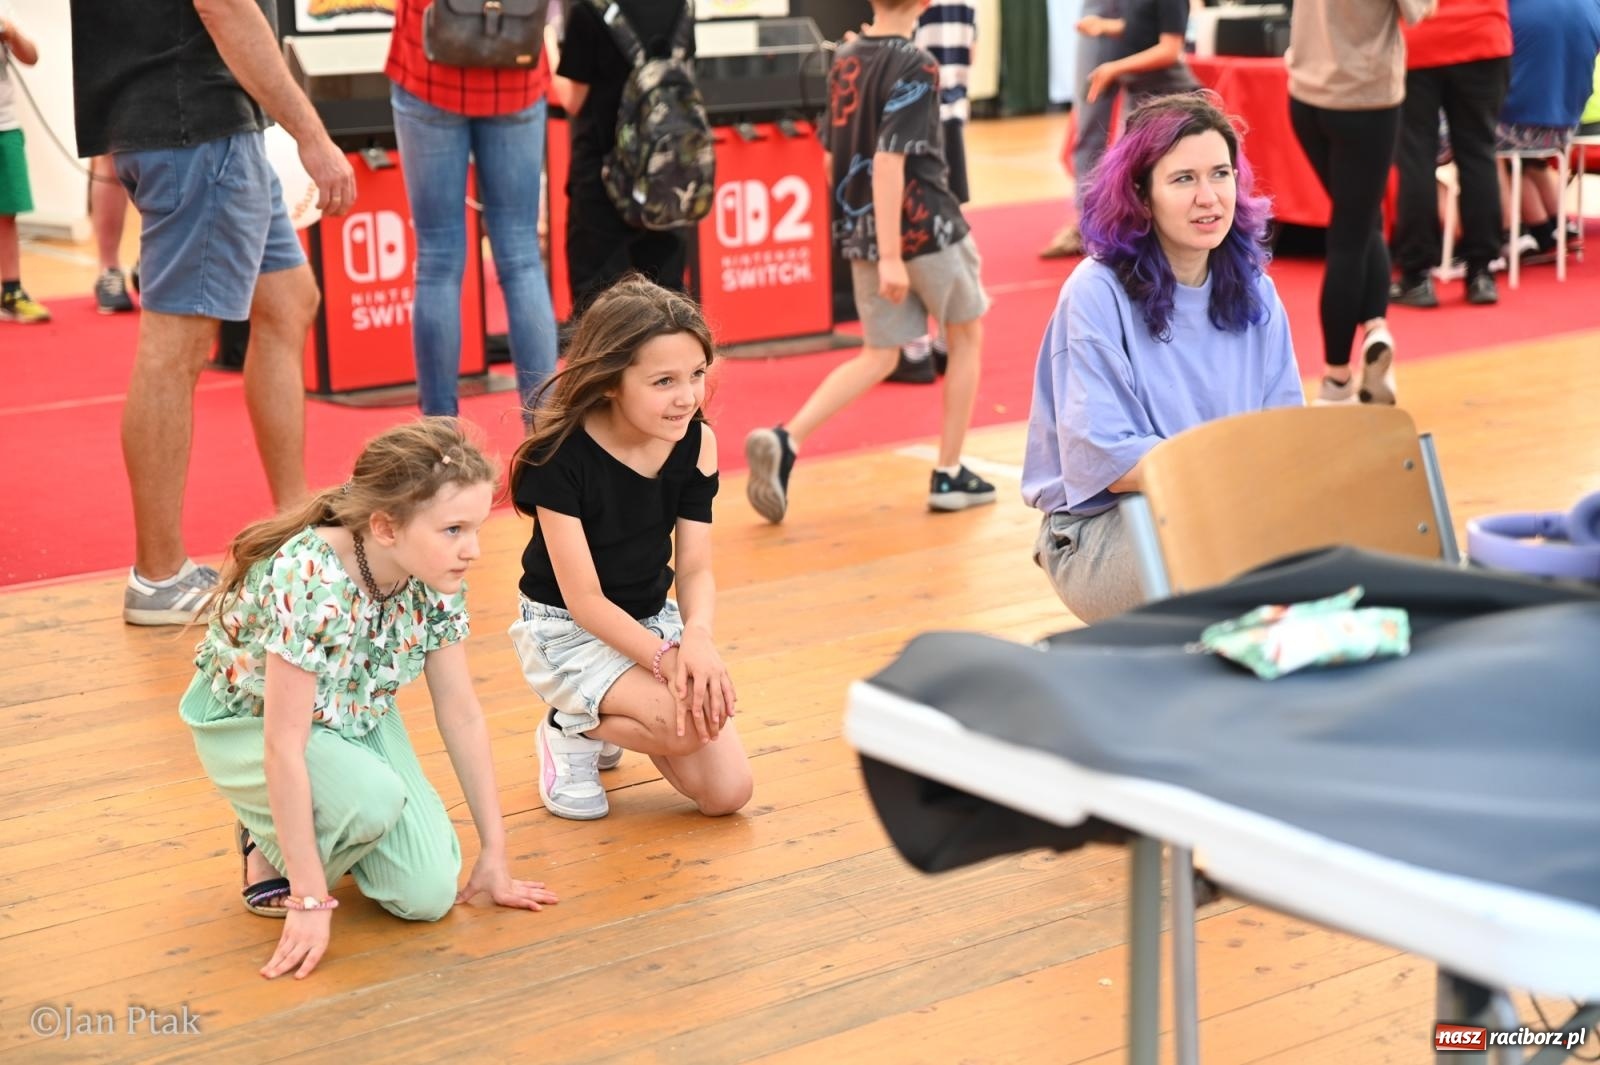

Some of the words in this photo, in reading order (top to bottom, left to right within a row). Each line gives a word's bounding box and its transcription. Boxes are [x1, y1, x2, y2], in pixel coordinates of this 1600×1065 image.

[771, 175, 814, 243] 2
[722, 262, 812, 291] SWITCH
[352, 302, 413, 331] SWIT
